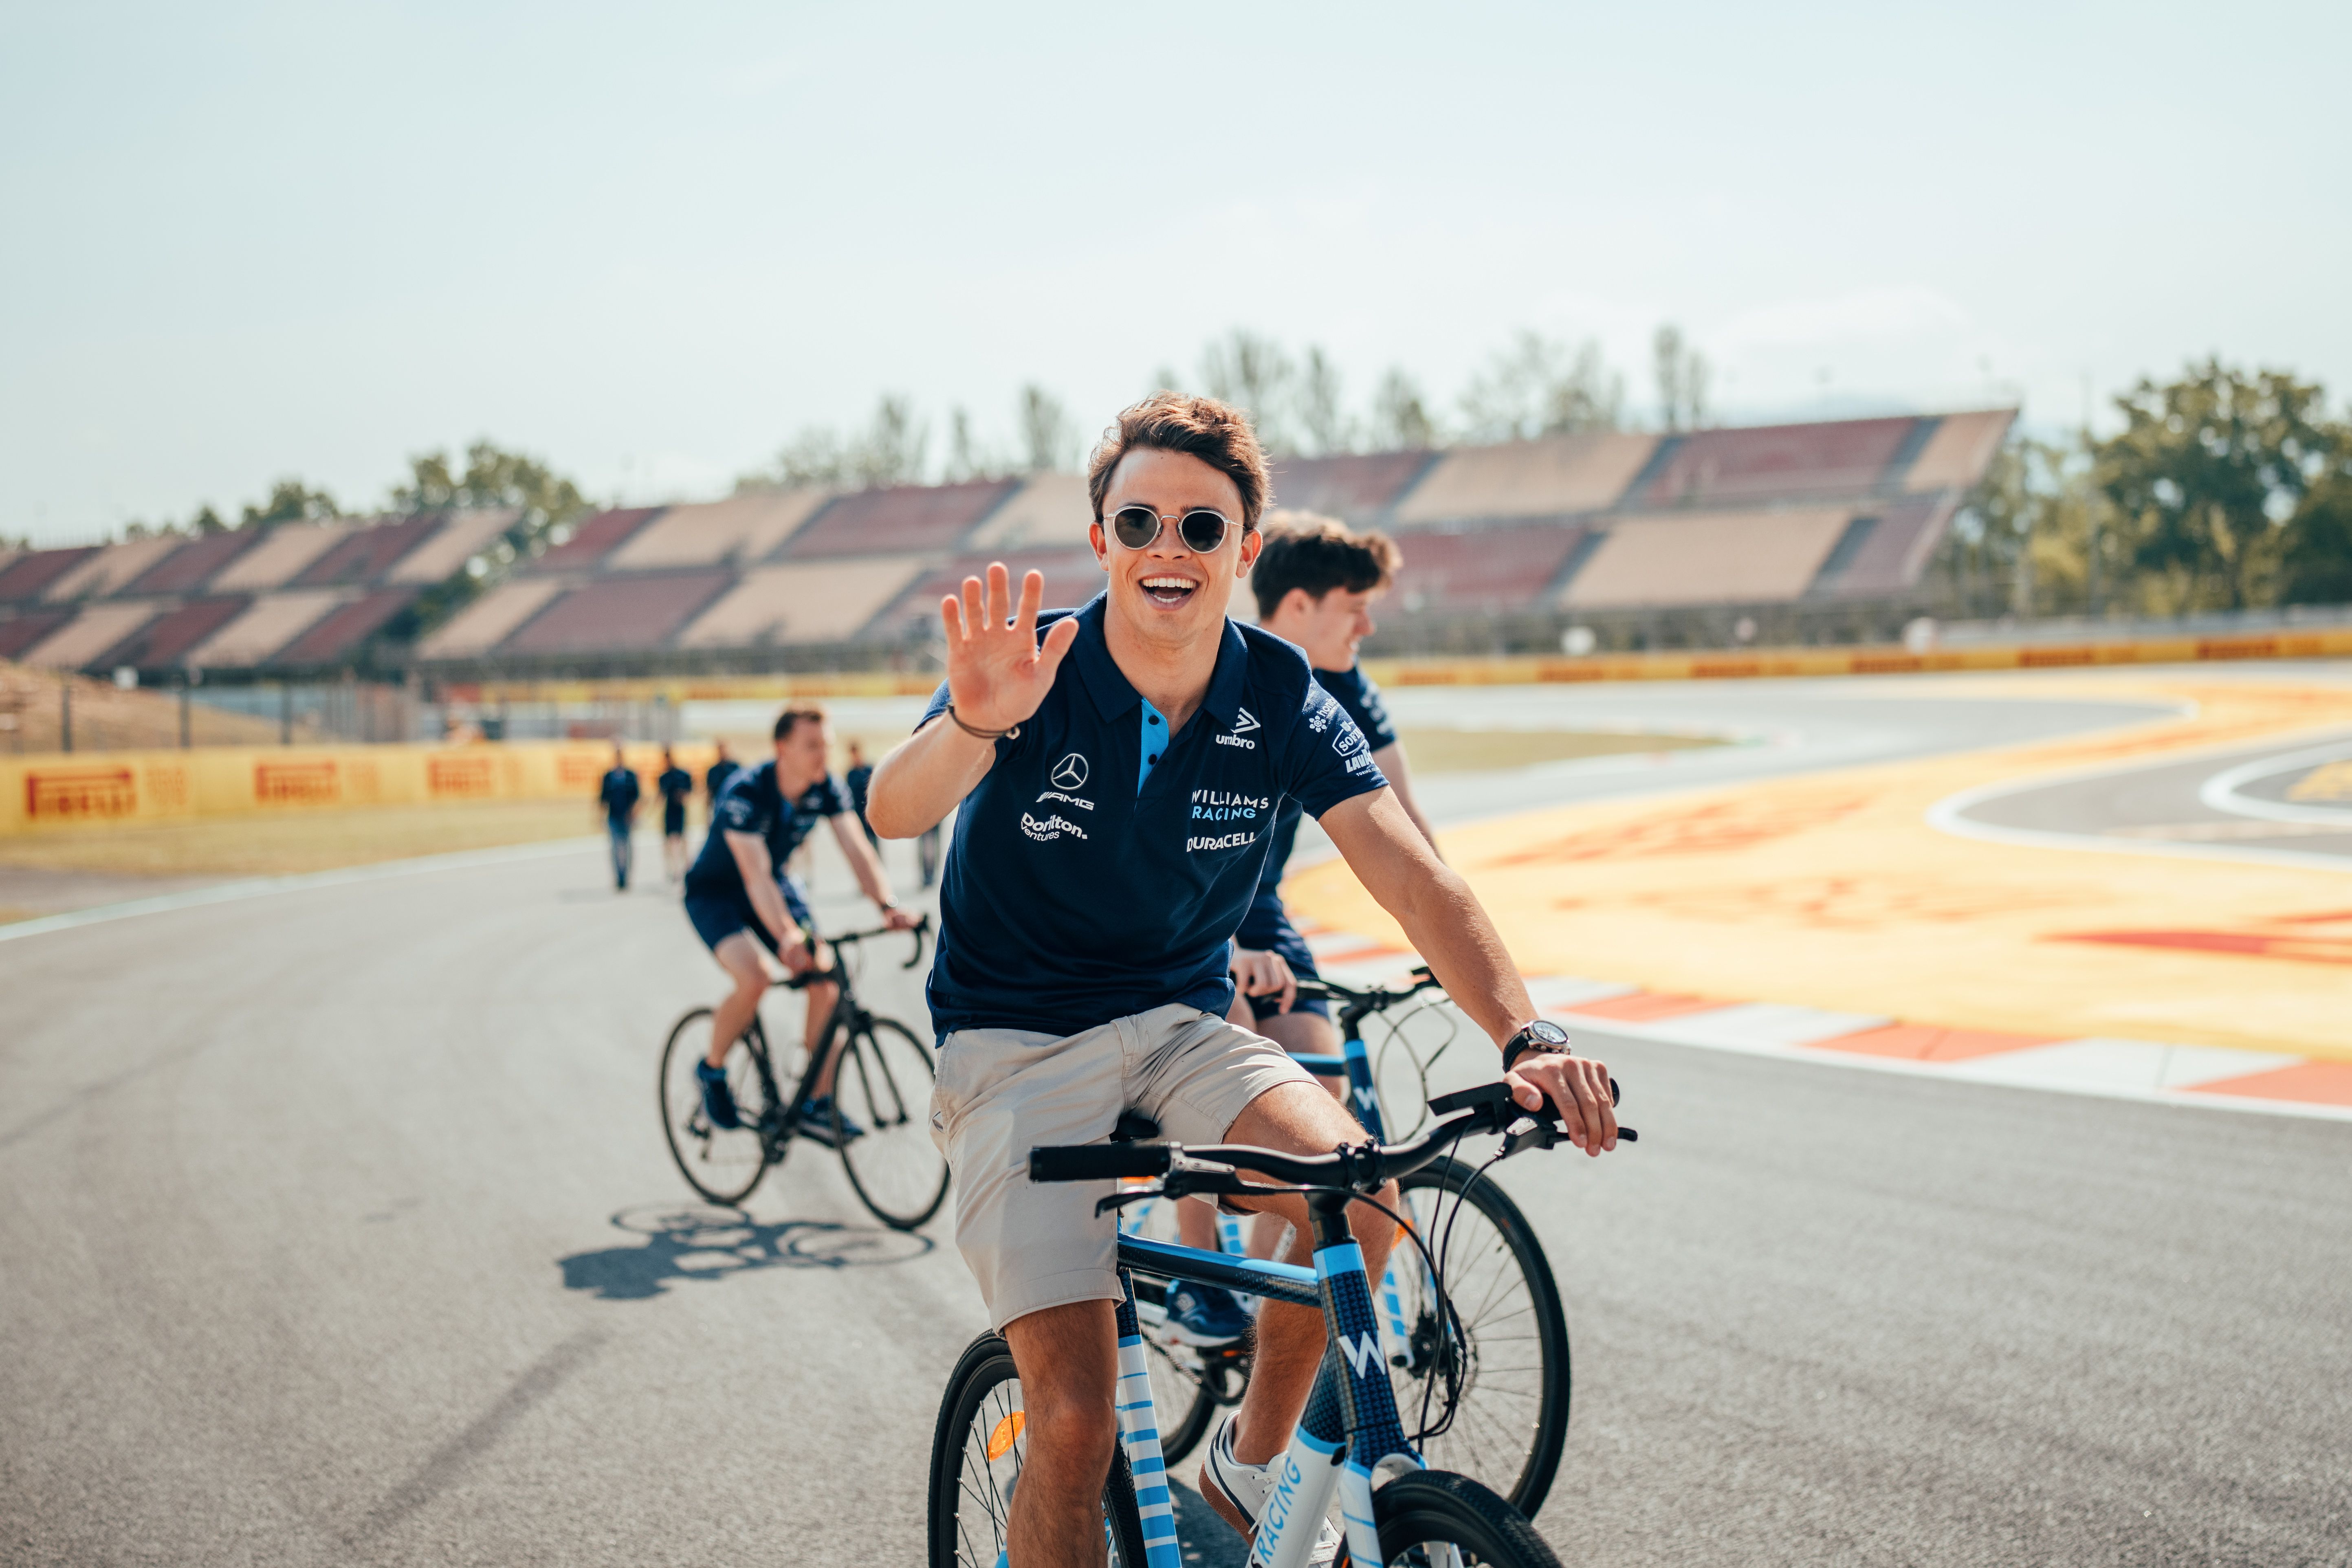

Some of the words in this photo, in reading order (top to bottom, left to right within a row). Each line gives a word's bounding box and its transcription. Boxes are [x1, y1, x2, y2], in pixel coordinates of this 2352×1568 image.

[1216, 734, 1255, 749] umbro
[1345, 749, 1375, 773] LAVA
[1192, 789, 1269, 809] WILLIAMS
[1192, 806, 1256, 820] RACING
[1021, 821, 1060, 841] Ventures
[1186, 832, 1256, 852] DURACELL
[1256, 1457, 1301, 1565] RACING
